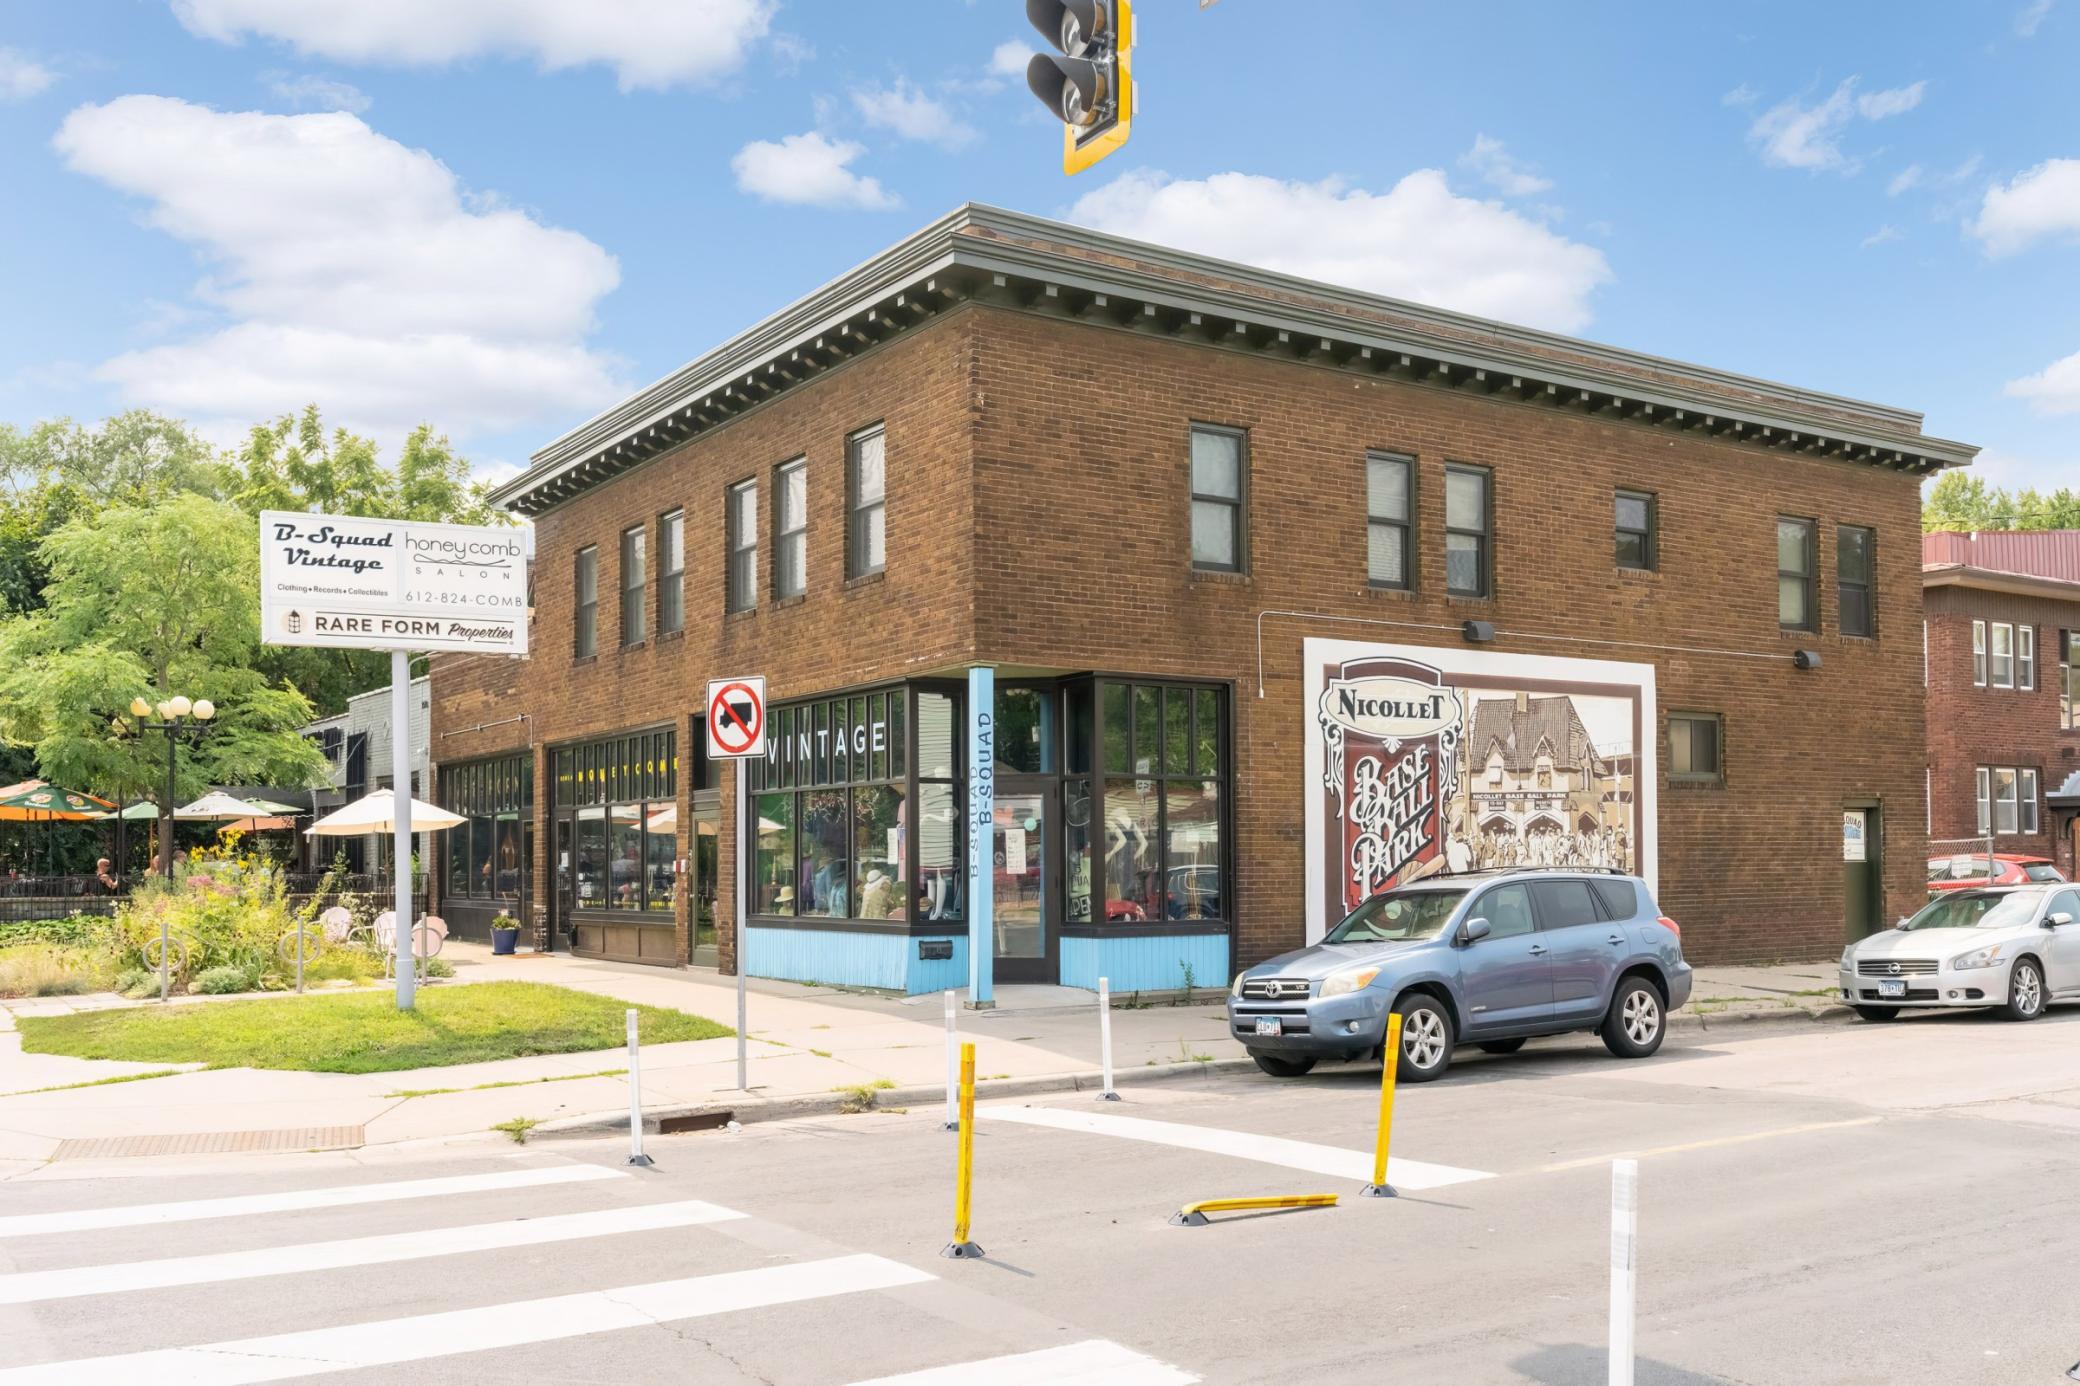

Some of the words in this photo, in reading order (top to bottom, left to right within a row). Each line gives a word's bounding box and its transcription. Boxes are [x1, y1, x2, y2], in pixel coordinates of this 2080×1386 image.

[273, 523, 393, 548] B-Squad
[283, 547, 384, 573] Vintage
[277, 583, 308, 593] Clothing
[313, 586, 343, 594] Records
[347, 587, 389, 597] Collectibles
[405, 591, 523, 607] 612-824-COMB
[315, 616, 373, 632] RARE
[381, 620, 440, 635] FORM
[448, 623, 514, 641] Properties
[1338, 688, 1445, 722] NICOLLET
[767, 722, 885, 764] VINTAGE
[978, 712, 993, 826] B-SQUAD
[969, 766, 979, 878] B-SQUAD
